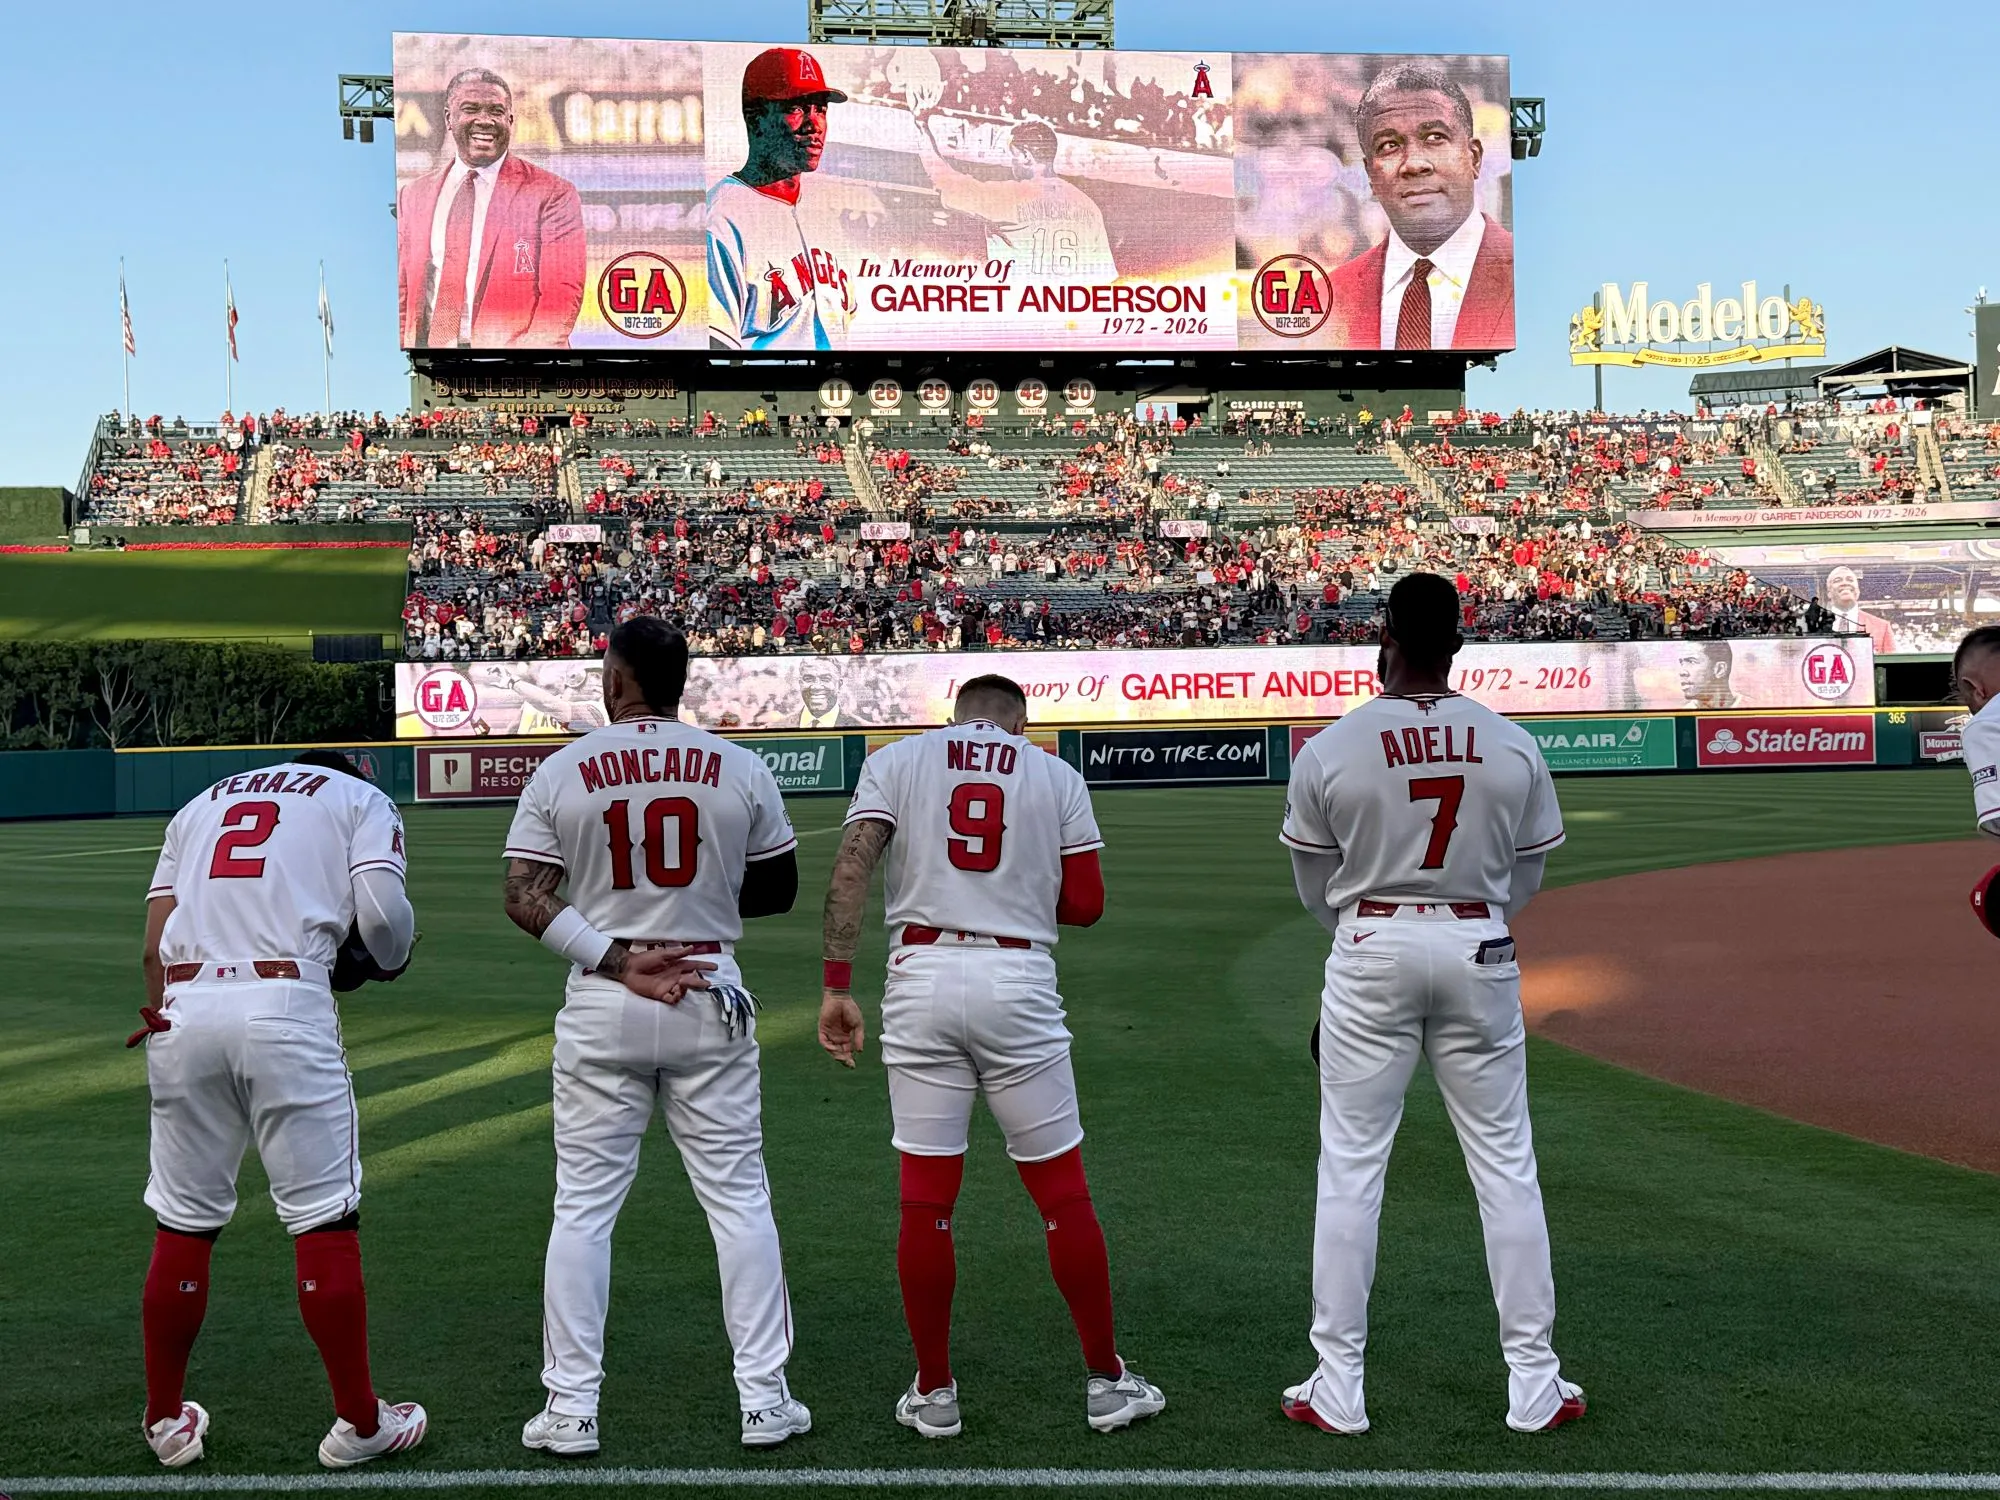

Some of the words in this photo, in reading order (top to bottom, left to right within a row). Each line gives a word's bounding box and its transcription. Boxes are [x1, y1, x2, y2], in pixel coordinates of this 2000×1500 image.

[1031, 228, 1078, 276] 16
[857, 258, 881, 278] In
[888, 258, 978, 283] Memory
[984, 259, 1015, 283] Of
[609, 268, 676, 315] GA
[764, 248, 849, 328] ANGES
[870, 284, 1011, 312] GARRET
[1018, 286, 1206, 313] ANDERSON
[1260, 270, 1324, 314] GA
[624, 317, 662, 329] 1972-2026
[1275, 317, 1311, 328] 1972-2026
[1601, 280, 1790, 345] Modelo
[1102, 318, 1145, 334] 1972
[1163, 318, 1208, 335] 2026
[1684, 355, 1711, 365] 1925
[435, 377, 541, 398] BULLEIT
[556, 378, 677, 398] BOURBON
[829, 384, 843, 401] 11
[875, 384, 898, 401] 26
[923, 384, 947, 401] 29
[972, 383, 995, 400] 30
[1020, 383, 1043, 400] 42
[1068, 383, 1091, 400] 50
[1230, 401, 1275, 409] CLASSIC
[1693, 513, 1702, 523] In
[1704, 512, 1740, 524] Memory
[1761, 511, 1801, 521] GARRET
[1804, 509, 1862, 520] ANDERSON
[1866, 508, 1892, 519] 1972
[1901, 506, 1928, 518] 2026
[1808, 654, 1849, 684] GA
[421, 680, 468, 712] GA
[1077, 675, 1109, 702] Of
[1121, 672, 1255, 700] GARRET
[1262, 670, 1384, 698] ANDER
[1458, 668, 1513, 691] 1972
[1534, 667, 1591, 690] 2026
[1887, 713, 1907, 724] 365
[1090, 744, 1155, 766] NITTO
[1161, 742, 1261, 765] TIRE.COM
[1380, 726, 1483, 768] ADELL
[1534, 735, 1571, 748] VA
[578, 748, 722, 793] MONCADA
[759, 746, 826, 772] ional
[947, 741, 1017, 775] NETO
[1551, 758, 1592, 766] ALLIANCE
[1593, 756, 1628, 765] MEMBER
[211, 772, 330, 801] PERAZA
[775, 774, 821, 786] Rental
[947, 782, 1007, 872] 9
[1409, 775, 1465, 870] 7
[209, 801, 280, 879] 2
[602, 796, 703, 890] 10
